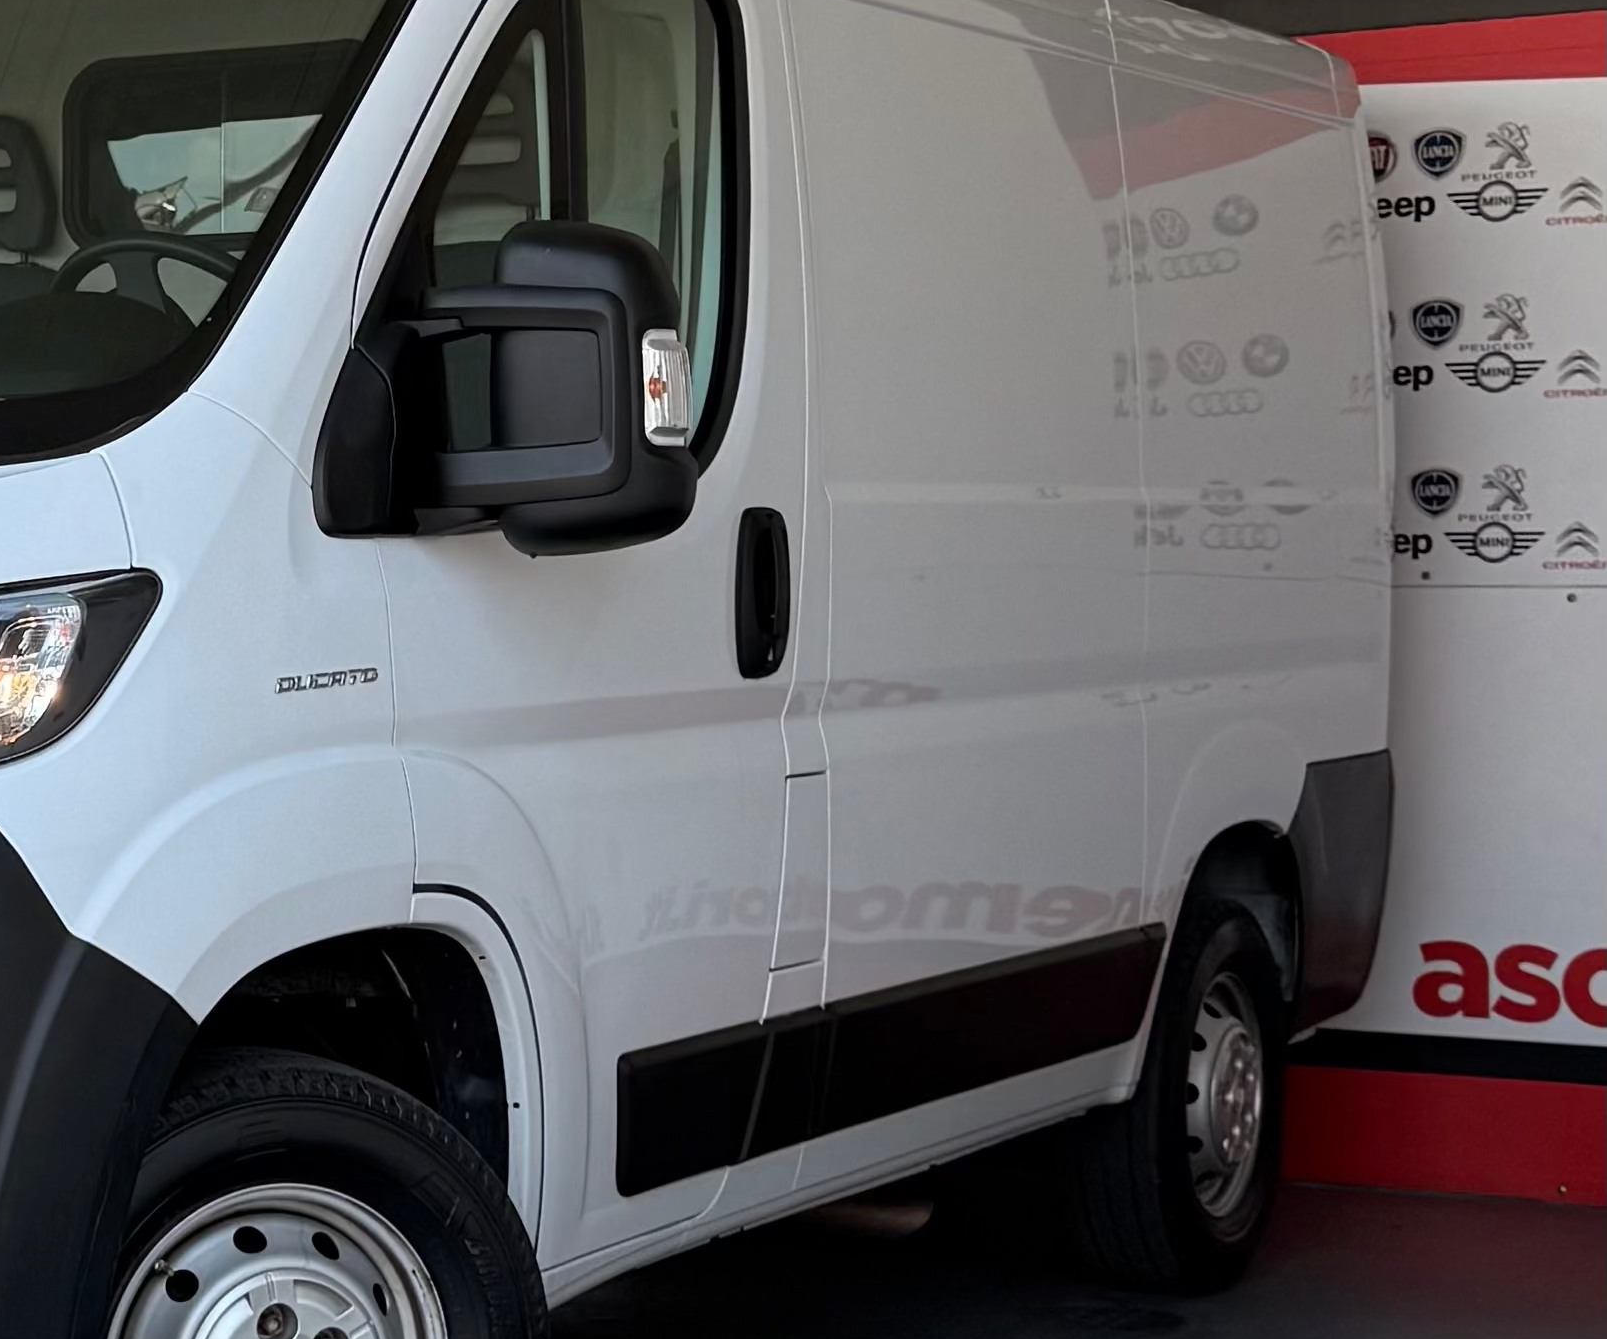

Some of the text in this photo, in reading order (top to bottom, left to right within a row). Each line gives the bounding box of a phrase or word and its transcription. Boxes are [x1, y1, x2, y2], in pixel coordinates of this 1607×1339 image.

[1460, 169, 1538, 183] PEUGEOT
[1481, 195, 1513, 207] MINI
[1377, 195, 1436, 223] eep
[1480, 366, 1512, 378] MINI
[1478, 537, 1511, 549] MINI
[275, 667, 379, 694] DUCATO
